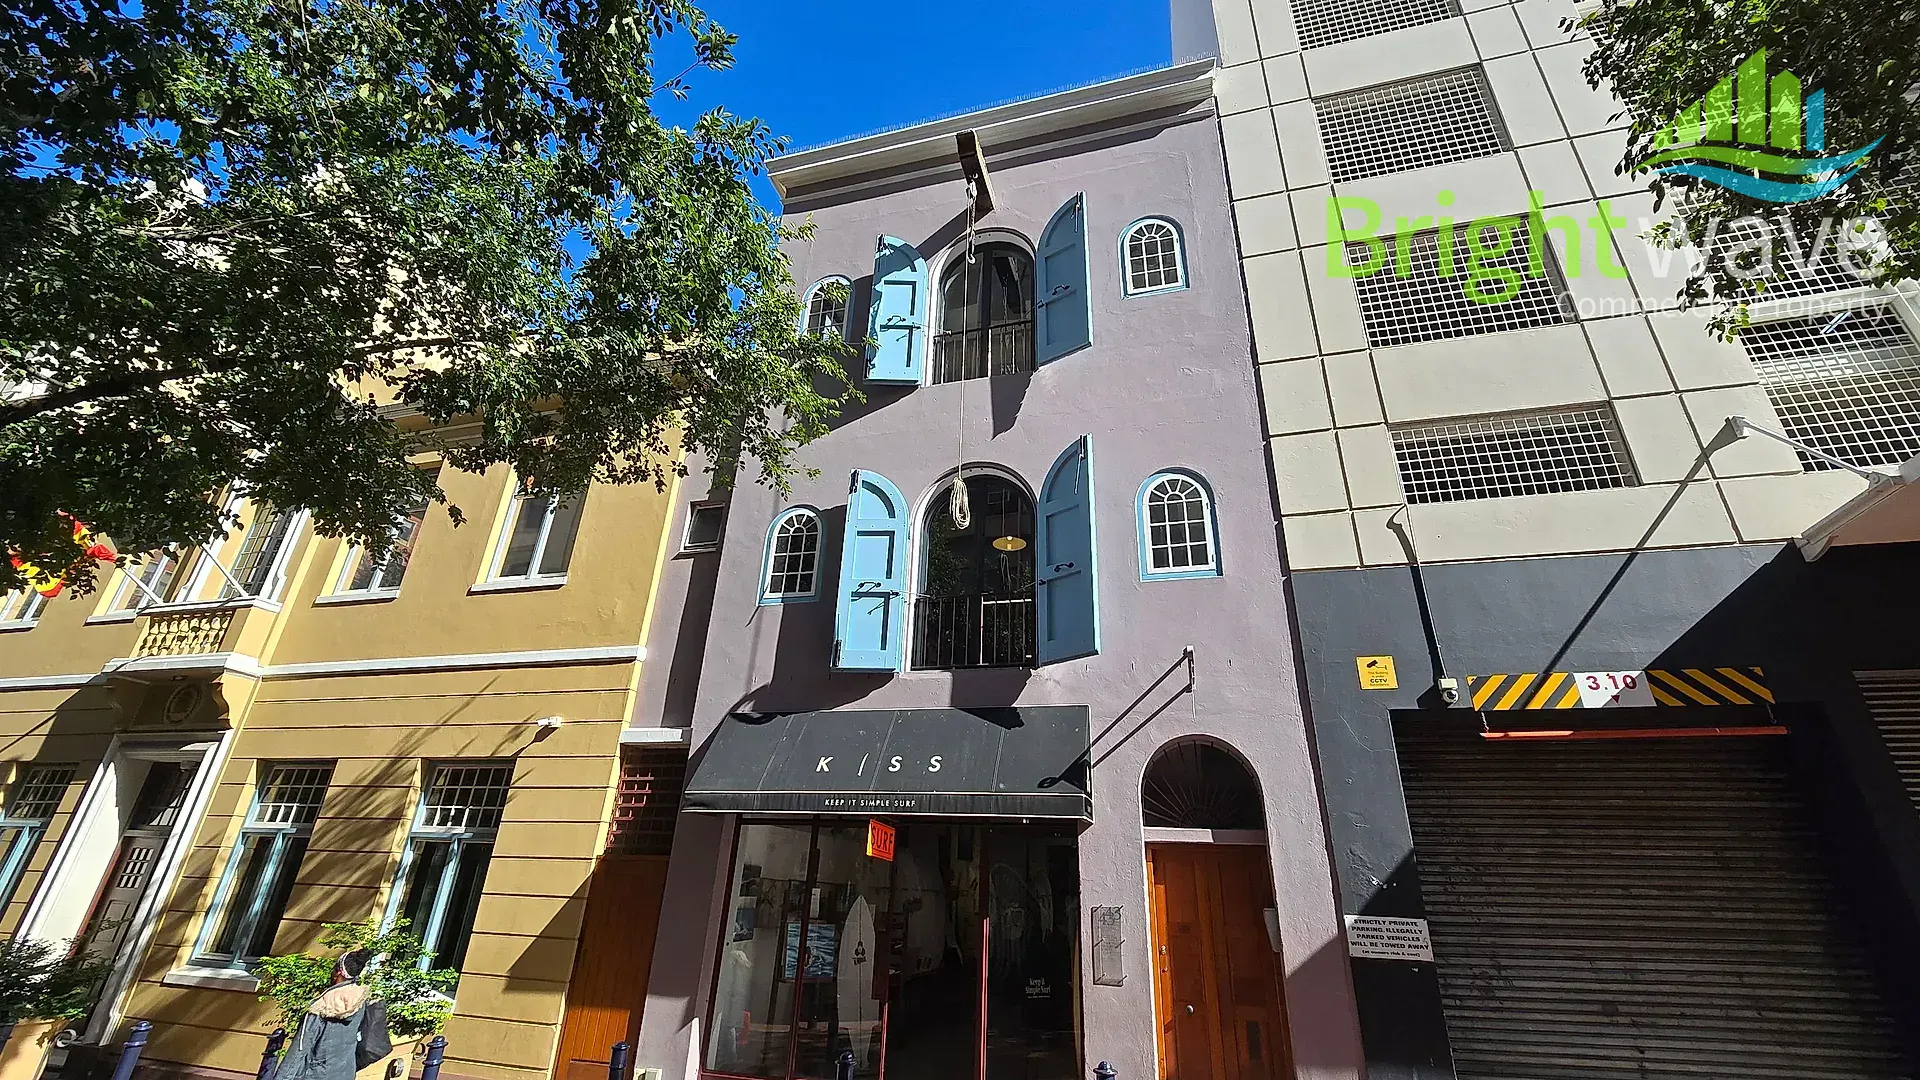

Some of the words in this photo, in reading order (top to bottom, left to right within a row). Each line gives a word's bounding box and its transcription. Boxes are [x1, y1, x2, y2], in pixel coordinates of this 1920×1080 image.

[1586, 675, 1637, 691] 3.10
[860, 799, 890, 807] SIMPLE
[871, 825, 894, 852] SURF
